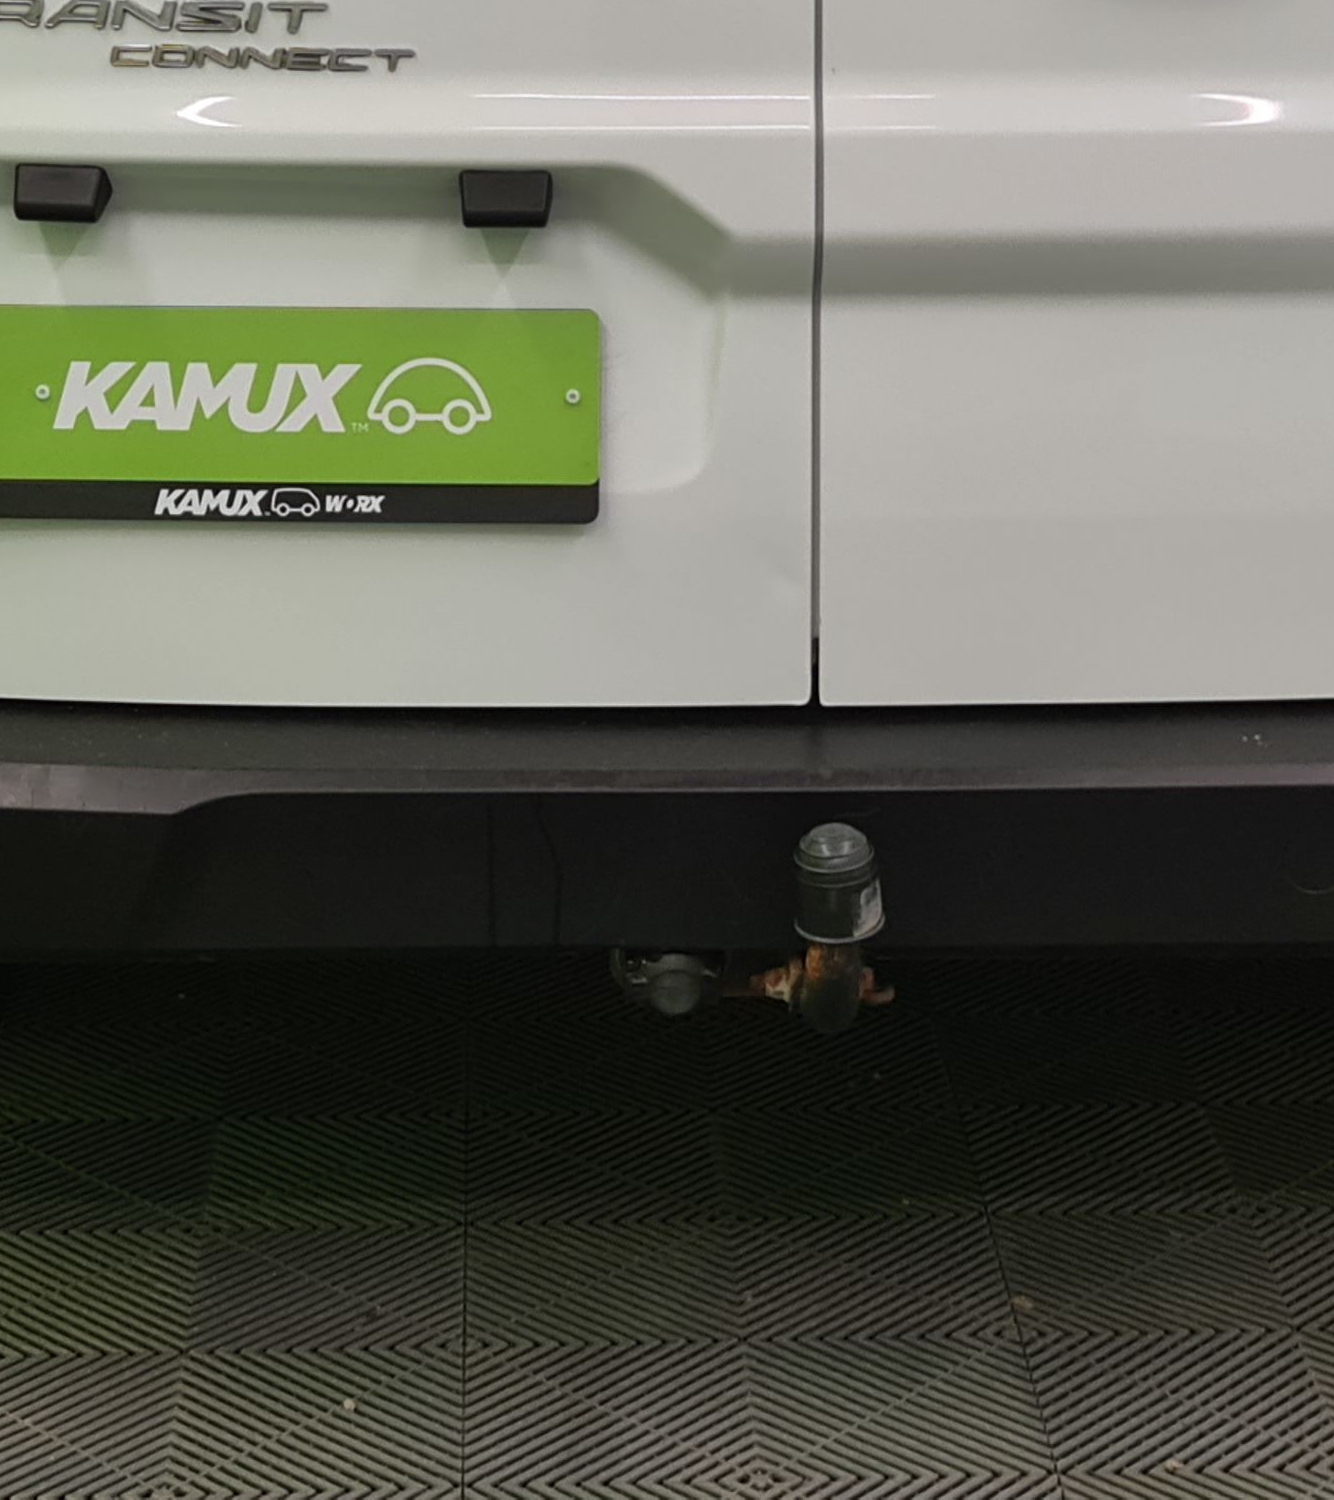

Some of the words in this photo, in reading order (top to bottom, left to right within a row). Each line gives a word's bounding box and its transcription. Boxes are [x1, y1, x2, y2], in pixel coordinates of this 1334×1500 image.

[110, 43, 415, 72] CONNECT
[53, 361, 362, 433] KAMUX
[154, 489, 267, 516] KAMUX
